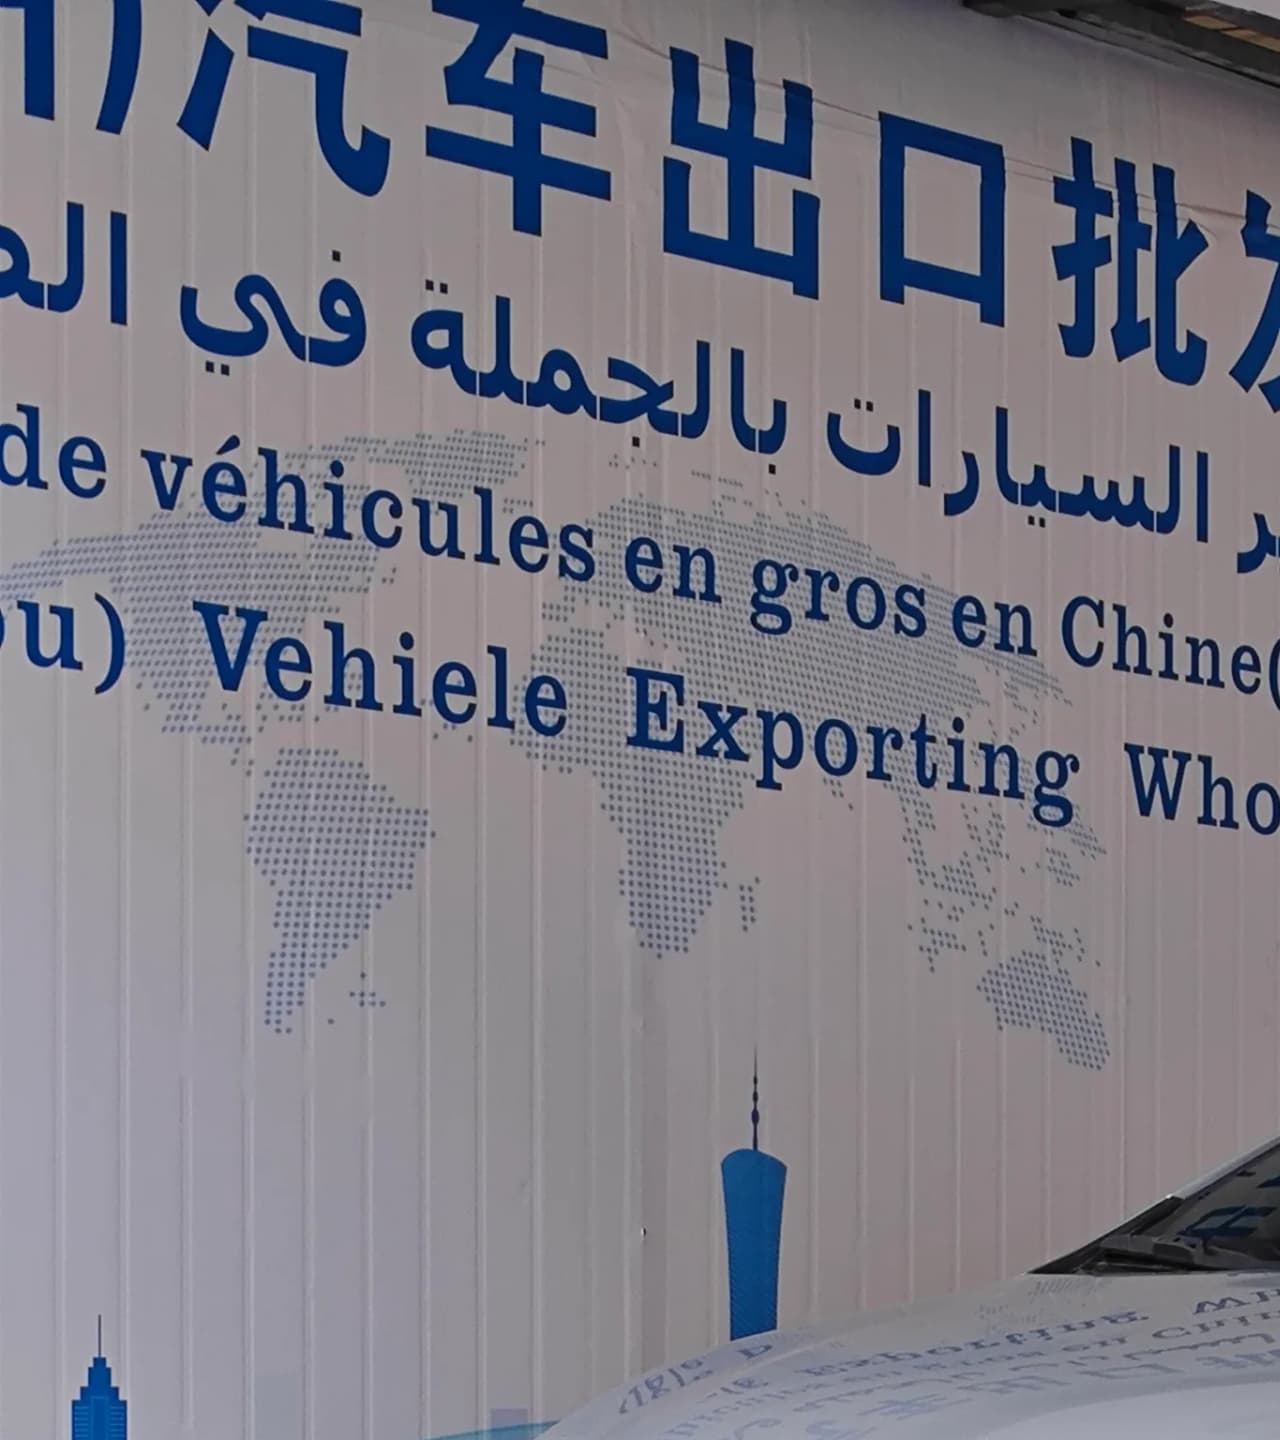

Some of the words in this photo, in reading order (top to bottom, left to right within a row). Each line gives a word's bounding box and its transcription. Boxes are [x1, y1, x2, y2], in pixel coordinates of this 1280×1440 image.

[179, 249, 367, 376] في
[410, 278, 788, 475] بالجملة
[140, 434, 597, 583] véhicules
[623, 534, 722, 604] en
[750, 557, 927, 637] gros
[951, 595, 1037, 657] en
[826, 389, 1209, 543] السيارات
[193, 598, 568, 738] Vehiele
[625, 665, 1081, 829] Exporting
